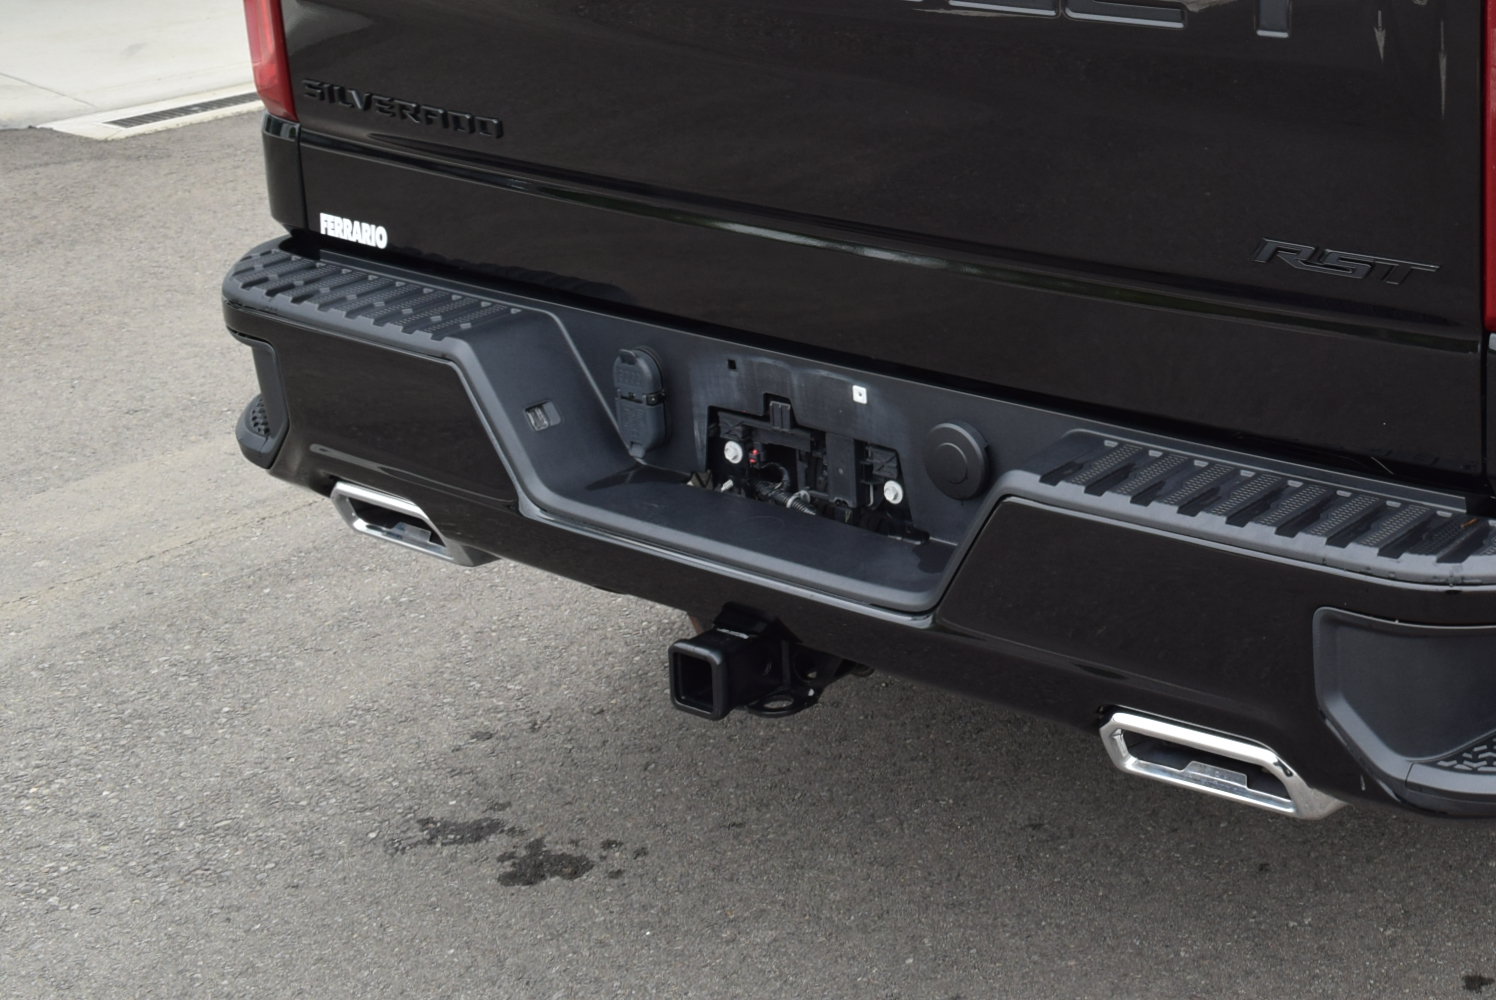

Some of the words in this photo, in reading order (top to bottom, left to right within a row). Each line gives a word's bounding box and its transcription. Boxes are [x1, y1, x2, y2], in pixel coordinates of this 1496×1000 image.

[301, 78, 505, 139] SILVERADO
[319, 212, 388, 250] FERRARIO
[1248, 236, 1441, 285] RST
